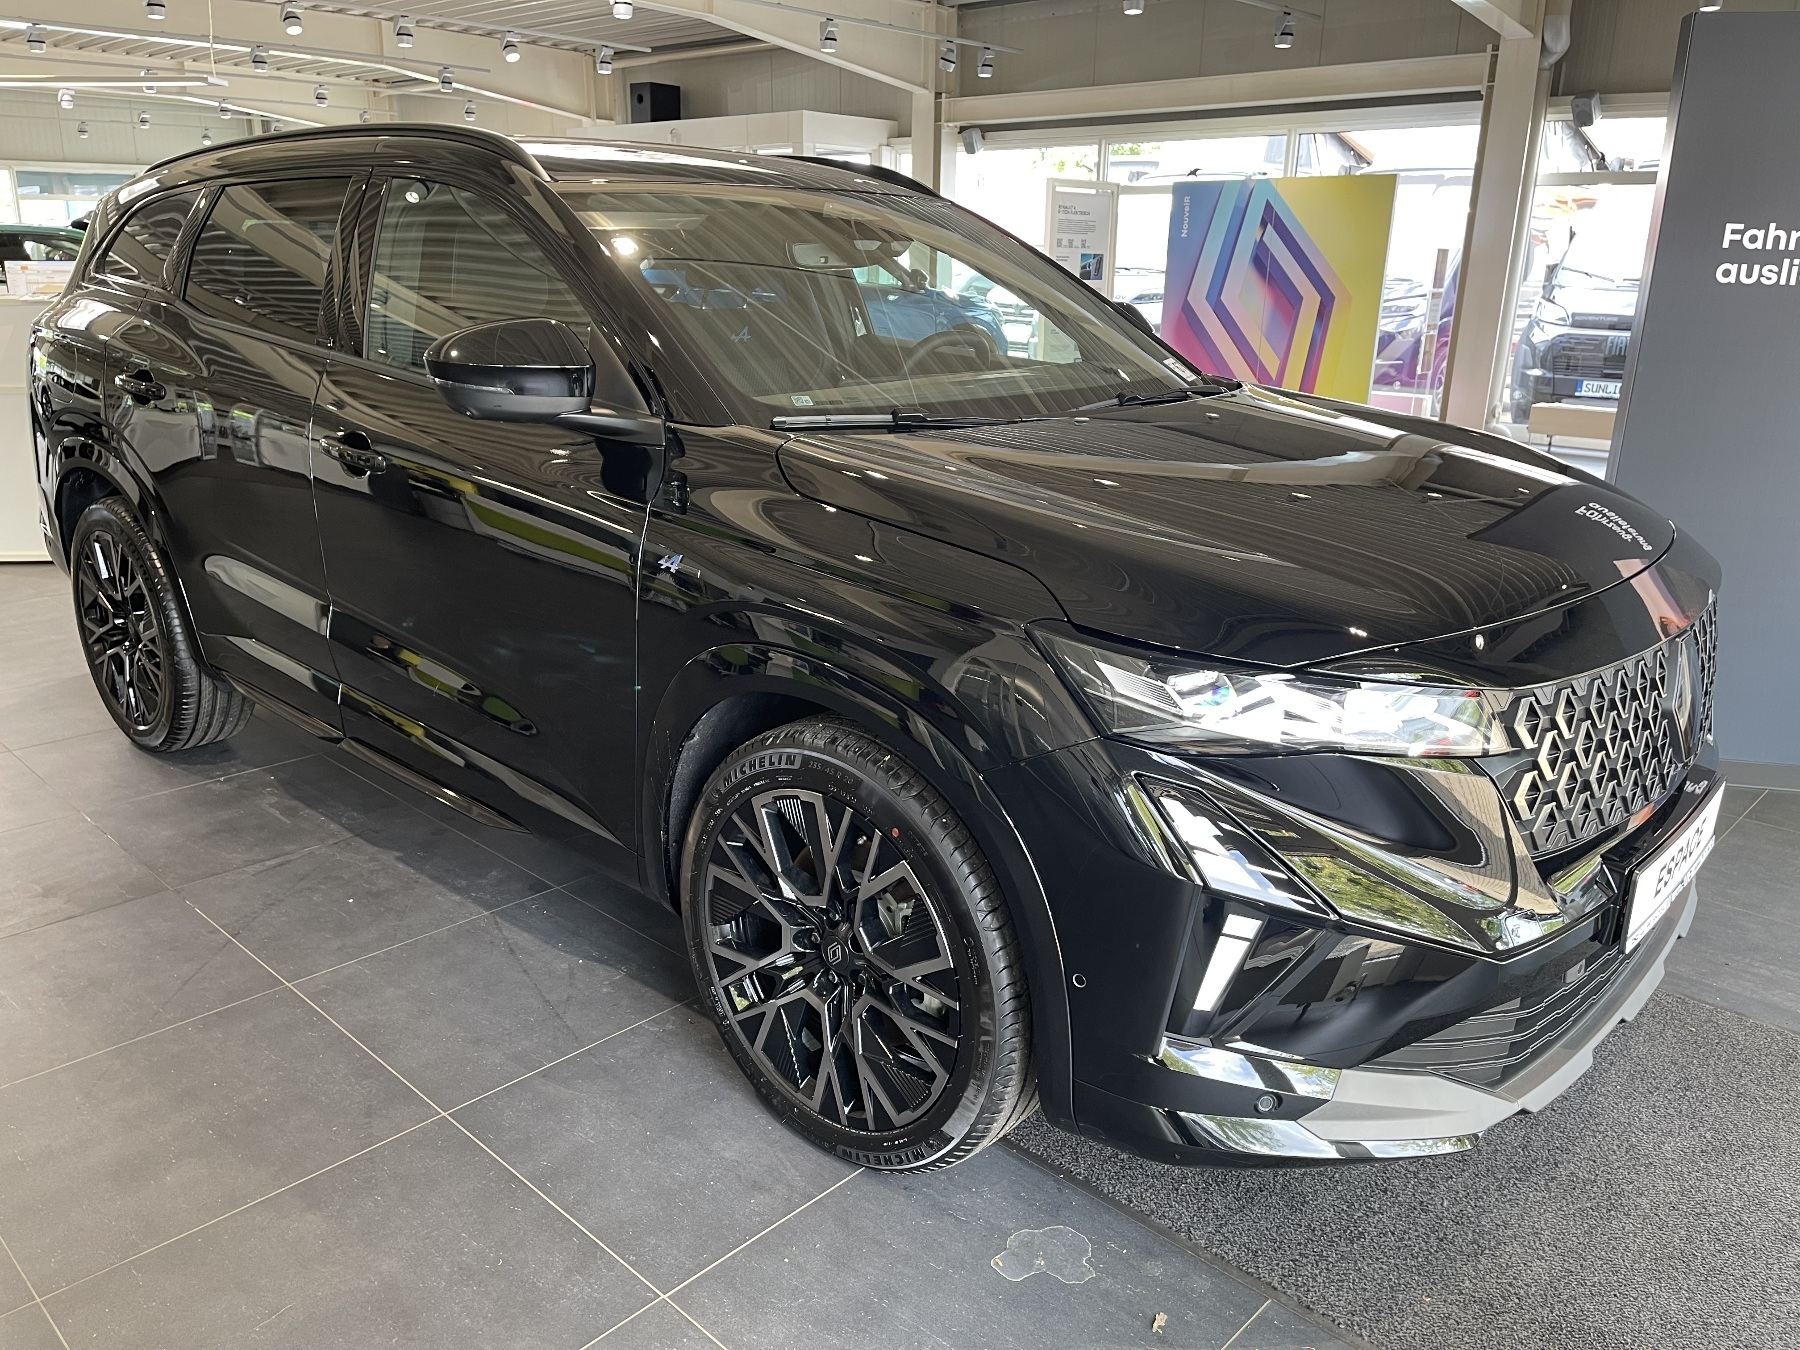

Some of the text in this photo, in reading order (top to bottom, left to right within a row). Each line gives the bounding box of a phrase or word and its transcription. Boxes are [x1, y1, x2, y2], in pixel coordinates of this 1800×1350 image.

[1605, 336, 1630, 356] FIA
[1583, 382, 1621, 395] SUNLI
[722, 754, 797, 788] MICHELIN
[1654, 816, 1708, 898] ESPACE
[841, 1145, 927, 1166] MICHELIN
